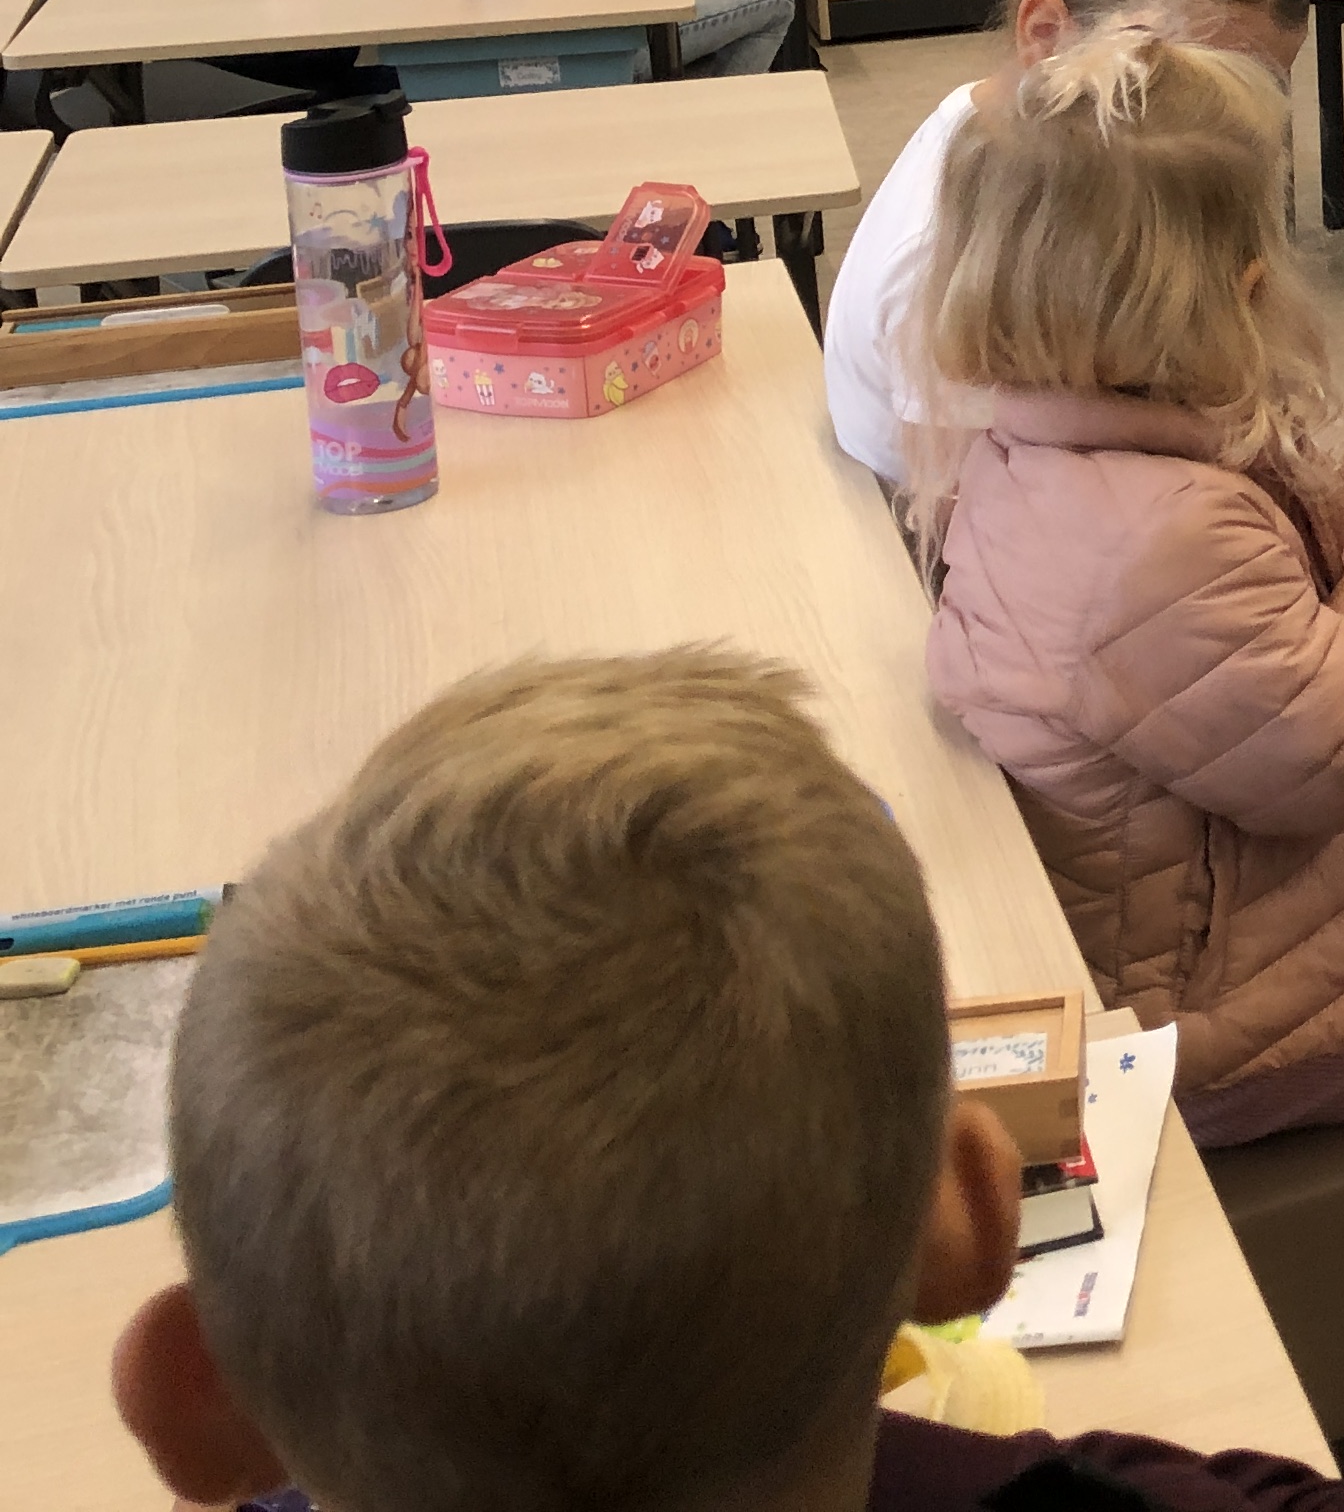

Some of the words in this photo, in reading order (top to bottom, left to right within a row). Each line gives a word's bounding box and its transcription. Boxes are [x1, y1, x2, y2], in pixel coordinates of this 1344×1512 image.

[12, 903, 111, 920] whiteboardmarker
[116, 898, 136, 908] met
[140, 894, 170, 905] ronde
[173, 890, 197, 902] punt
